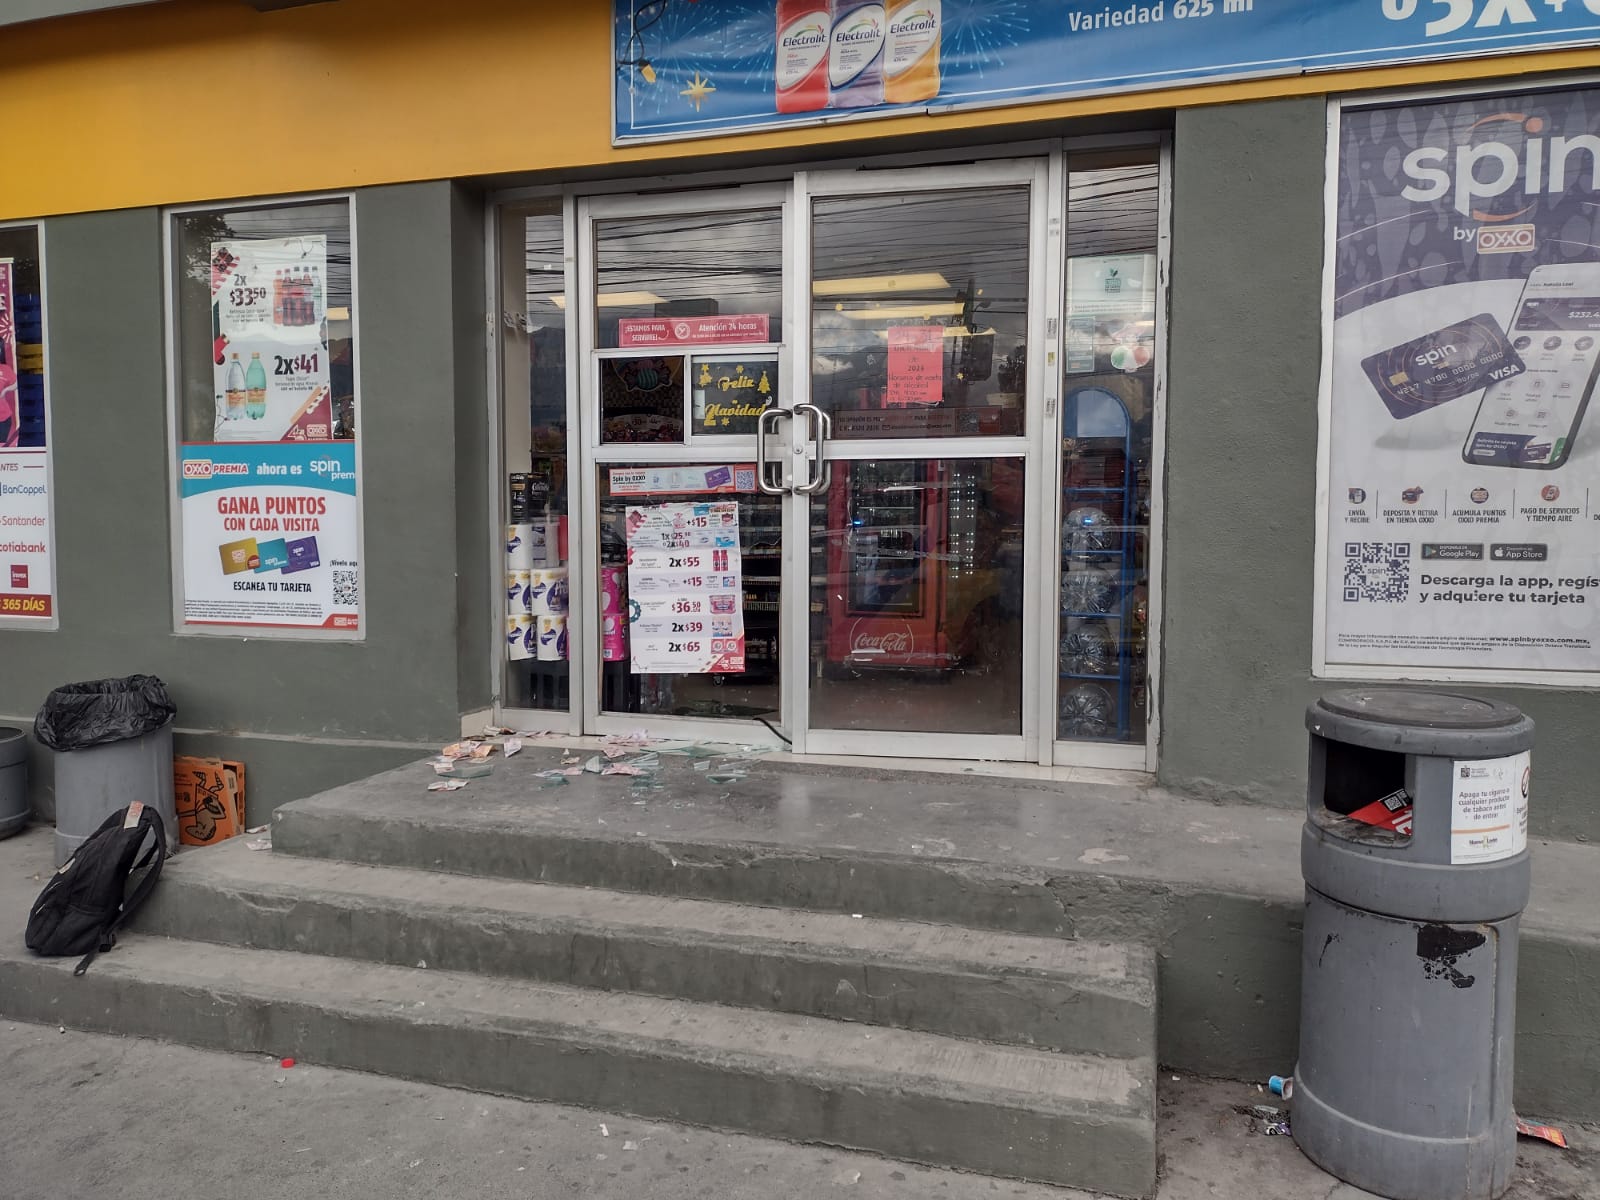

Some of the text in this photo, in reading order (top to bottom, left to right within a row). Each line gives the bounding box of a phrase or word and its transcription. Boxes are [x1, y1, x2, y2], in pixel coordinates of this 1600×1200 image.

[1069, 1, 1164, 32] Variedad
[1173, 0, 1214, 19] 625
[890, 20, 937, 34] Electrolit
[783, 34, 827, 47] Electrolit
[836, 29, 881, 43] Electrolit
[1401, 116, 1600, 217] spin
[1453, 226, 1533, 250] by OXXO
[699, 322, 727, 332] Atención
[738, 322, 757, 330] horas
[1415, 343, 1457, 367] spin
[1487, 364, 1521, 381] VISA
[717, 375, 755, 391] Feliz
[705, 403, 767, 418] Navidad
[0, 463, 19, 471] NTES
[184, 459, 341, 475] OXXO PREMIA ahora es spin
[331, 471, 356, 481] prem
[2, 484, 46, 496] BanCoppel
[217, 496, 326, 515] GANA PUNTOS
[1520, 507, 1537, 515] PAGO
[1549, 507, 1580, 515] SERVICIOS
[2, 515, 46, 527] Santander
[223, 518, 320, 532] CON CADA VISITA
[1439, 550, 1480, 559] Google Play
[1506, 550, 1543, 559] App Store
[233, 581, 312, 593] ESCANEA TU TARJETA
[1420, 574, 1495, 588] Descarga
[1499, 574, 1513, 586] la
[1517, 577, 1554, 589] app,
[2, 596, 46, 612] 365 DÍAS
[1419, 590, 1585, 606] y adquiere tu tarjeta
